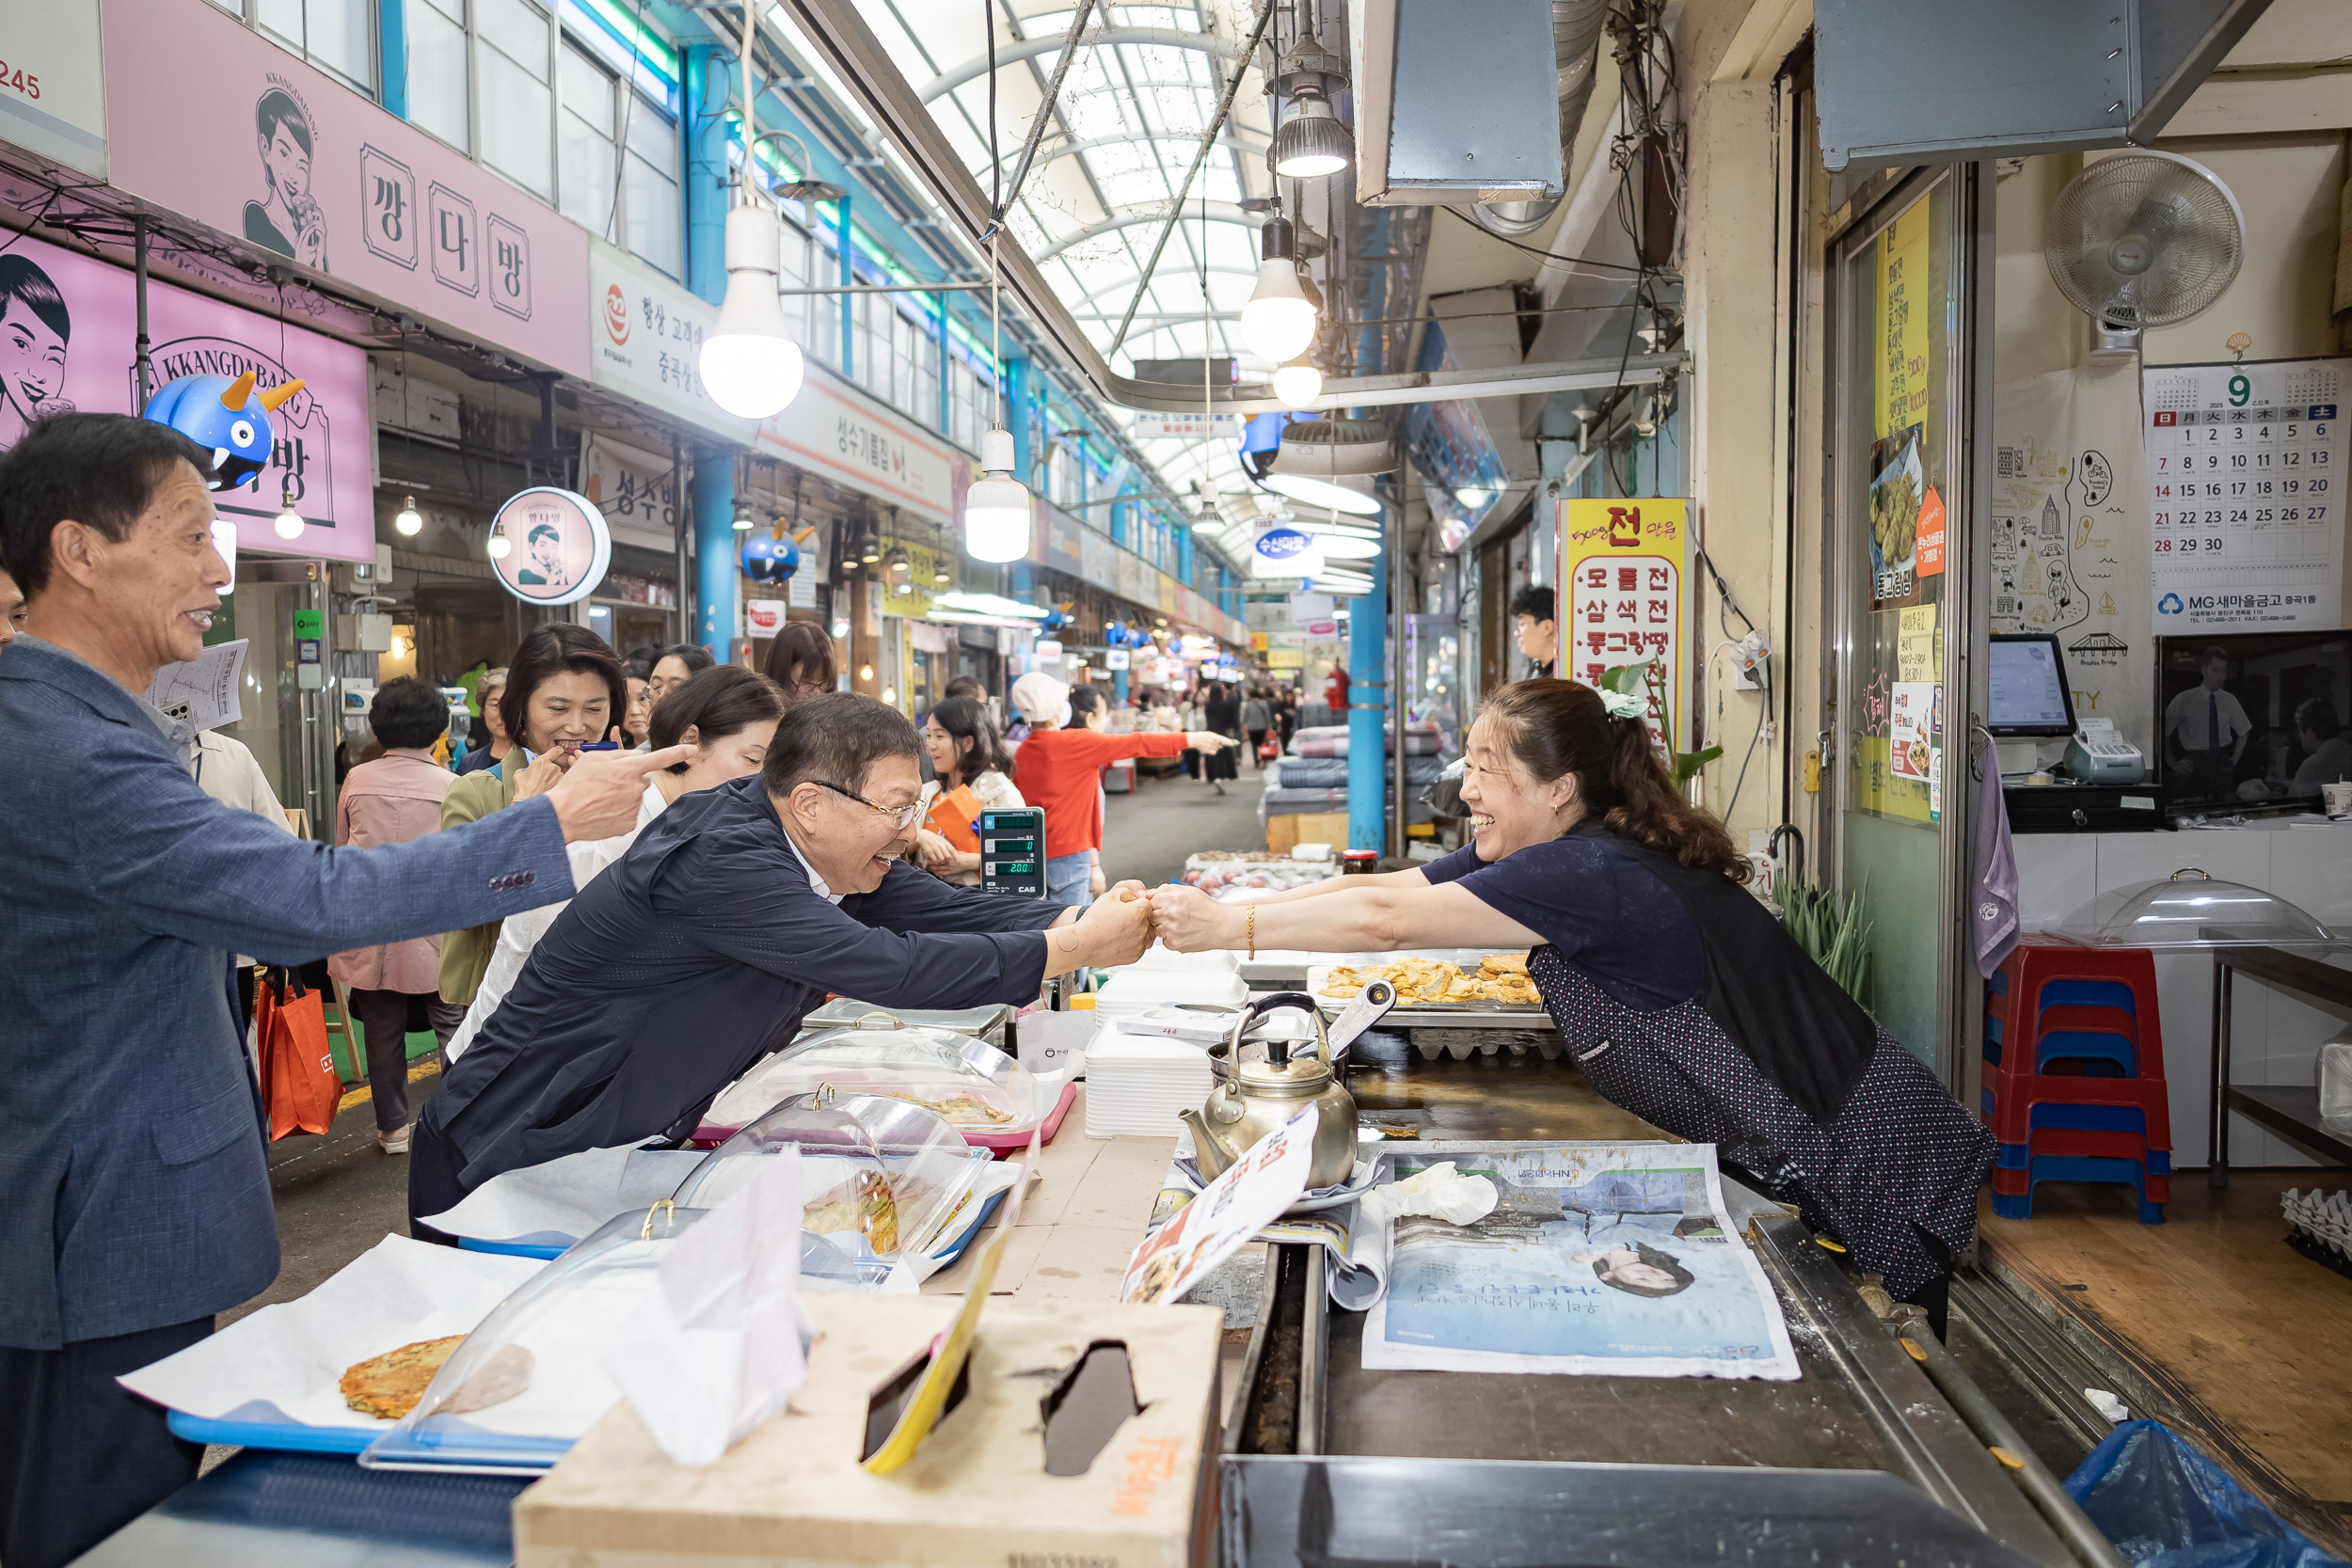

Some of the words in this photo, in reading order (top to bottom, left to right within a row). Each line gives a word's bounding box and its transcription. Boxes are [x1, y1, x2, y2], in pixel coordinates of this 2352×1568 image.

[265, 72, 320, 141] KKANGDABANG
[373, 174, 525, 298] 깡다방
[642, 296, 665, 337] 항상
[162, 349, 303, 414] KKANGDABAG
[2228, 374, 2251, 407] 9
[2159, 413, 2171, 424] 日
[2183, 412, 2195, 422] 月
[2206, 412, 2221, 421] 火
[2231, 410, 2247, 420] 水
[2256, 409, 2274, 420] 木
[2284, 407, 2303, 418] 金
[2313, 406, 2330, 417] 土
[2185, 429, 2190, 441] 1
[2209, 428, 2217, 440] 2
[2233, 427, 2243, 439] 3
[2259, 426, 2269, 438] 4
[2287, 424, 2297, 436] 5
[2315, 423, 2326, 436] 6
[2159, 457, 2168, 469] 7
[2183, 456, 2192, 468] 8
[2208, 455, 2217, 467] 9
[2231, 454, 2247, 467] 10
[2257, 453, 2270, 466] 11
[2282, 452, 2300, 465] 12
[2311, 451, 2328, 464] 13
[2154, 484, 2170, 498] 14
[2180, 483, 2196, 497] 15
[2205, 483, 2221, 496] 16
[2231, 482, 2247, 495] 17
[2256, 481, 2272, 494] 18
[2281, 480, 2298, 493] 19
[2308, 479, 2328, 492] 20
[2154, 512, 2170, 525] 21
[2179, 511, 2197, 524] 22
[2204, 511, 2222, 523] 23
[2230, 510, 2248, 522] 24
[2255, 509, 2273, 521] 25
[2280, 508, 2298, 520] 26
[2307, 506, 2327, 519] 27
[1607, 506, 1640, 546] 전
[2154, 539, 2171, 552] 28
[2179, 539, 2197, 551] 29
[2204, 538, 2222, 550] 30
[2189, 595, 2215, 610] MG
[2216, 594, 2281, 609] 새마을금고
[1586, 631, 1669, 656] 동그랑땡
[1586, 663, 1667, 688] 동전
[1528, 1297, 1561, 1312] 동네
[1565, 1298, 1600, 1314] 우리
